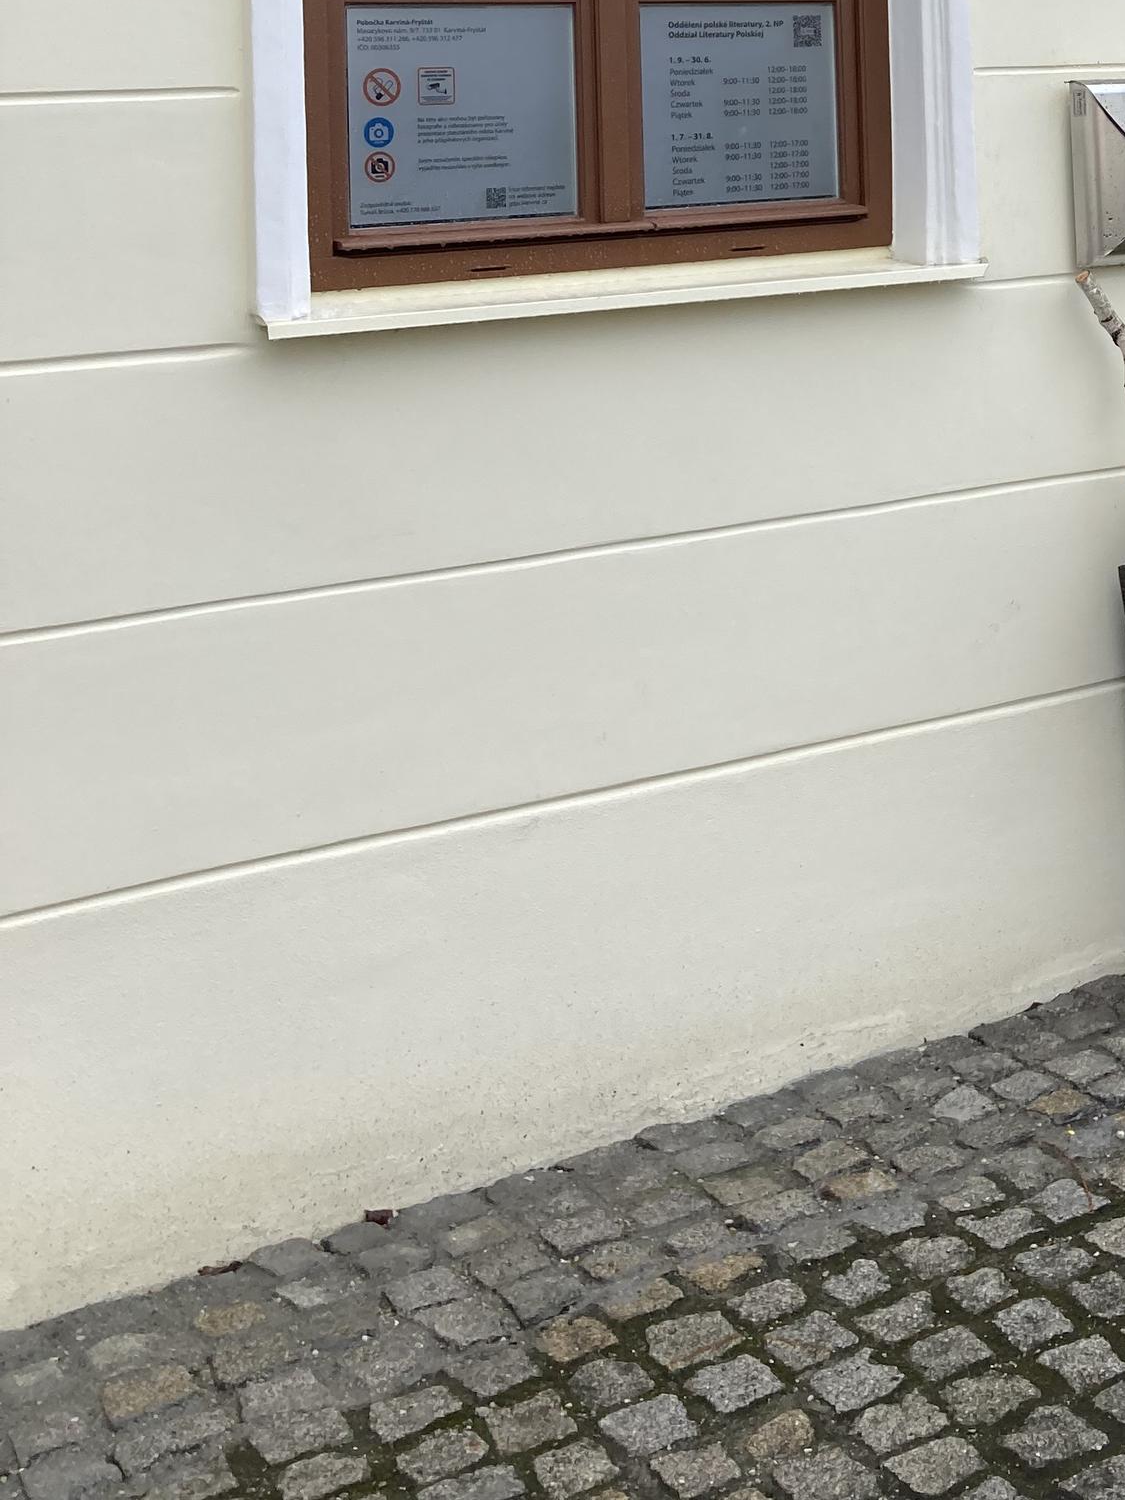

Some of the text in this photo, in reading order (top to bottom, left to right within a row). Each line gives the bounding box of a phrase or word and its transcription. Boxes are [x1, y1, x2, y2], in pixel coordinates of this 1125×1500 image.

[668, 21, 702, 29] Oddělení
[704, 21, 728, 30] polské
[729, 20, 764, 30] literatury,
[773, 20, 784, 28] NP
[668, 30, 764, 40] Oddział Literatury Polskiej
